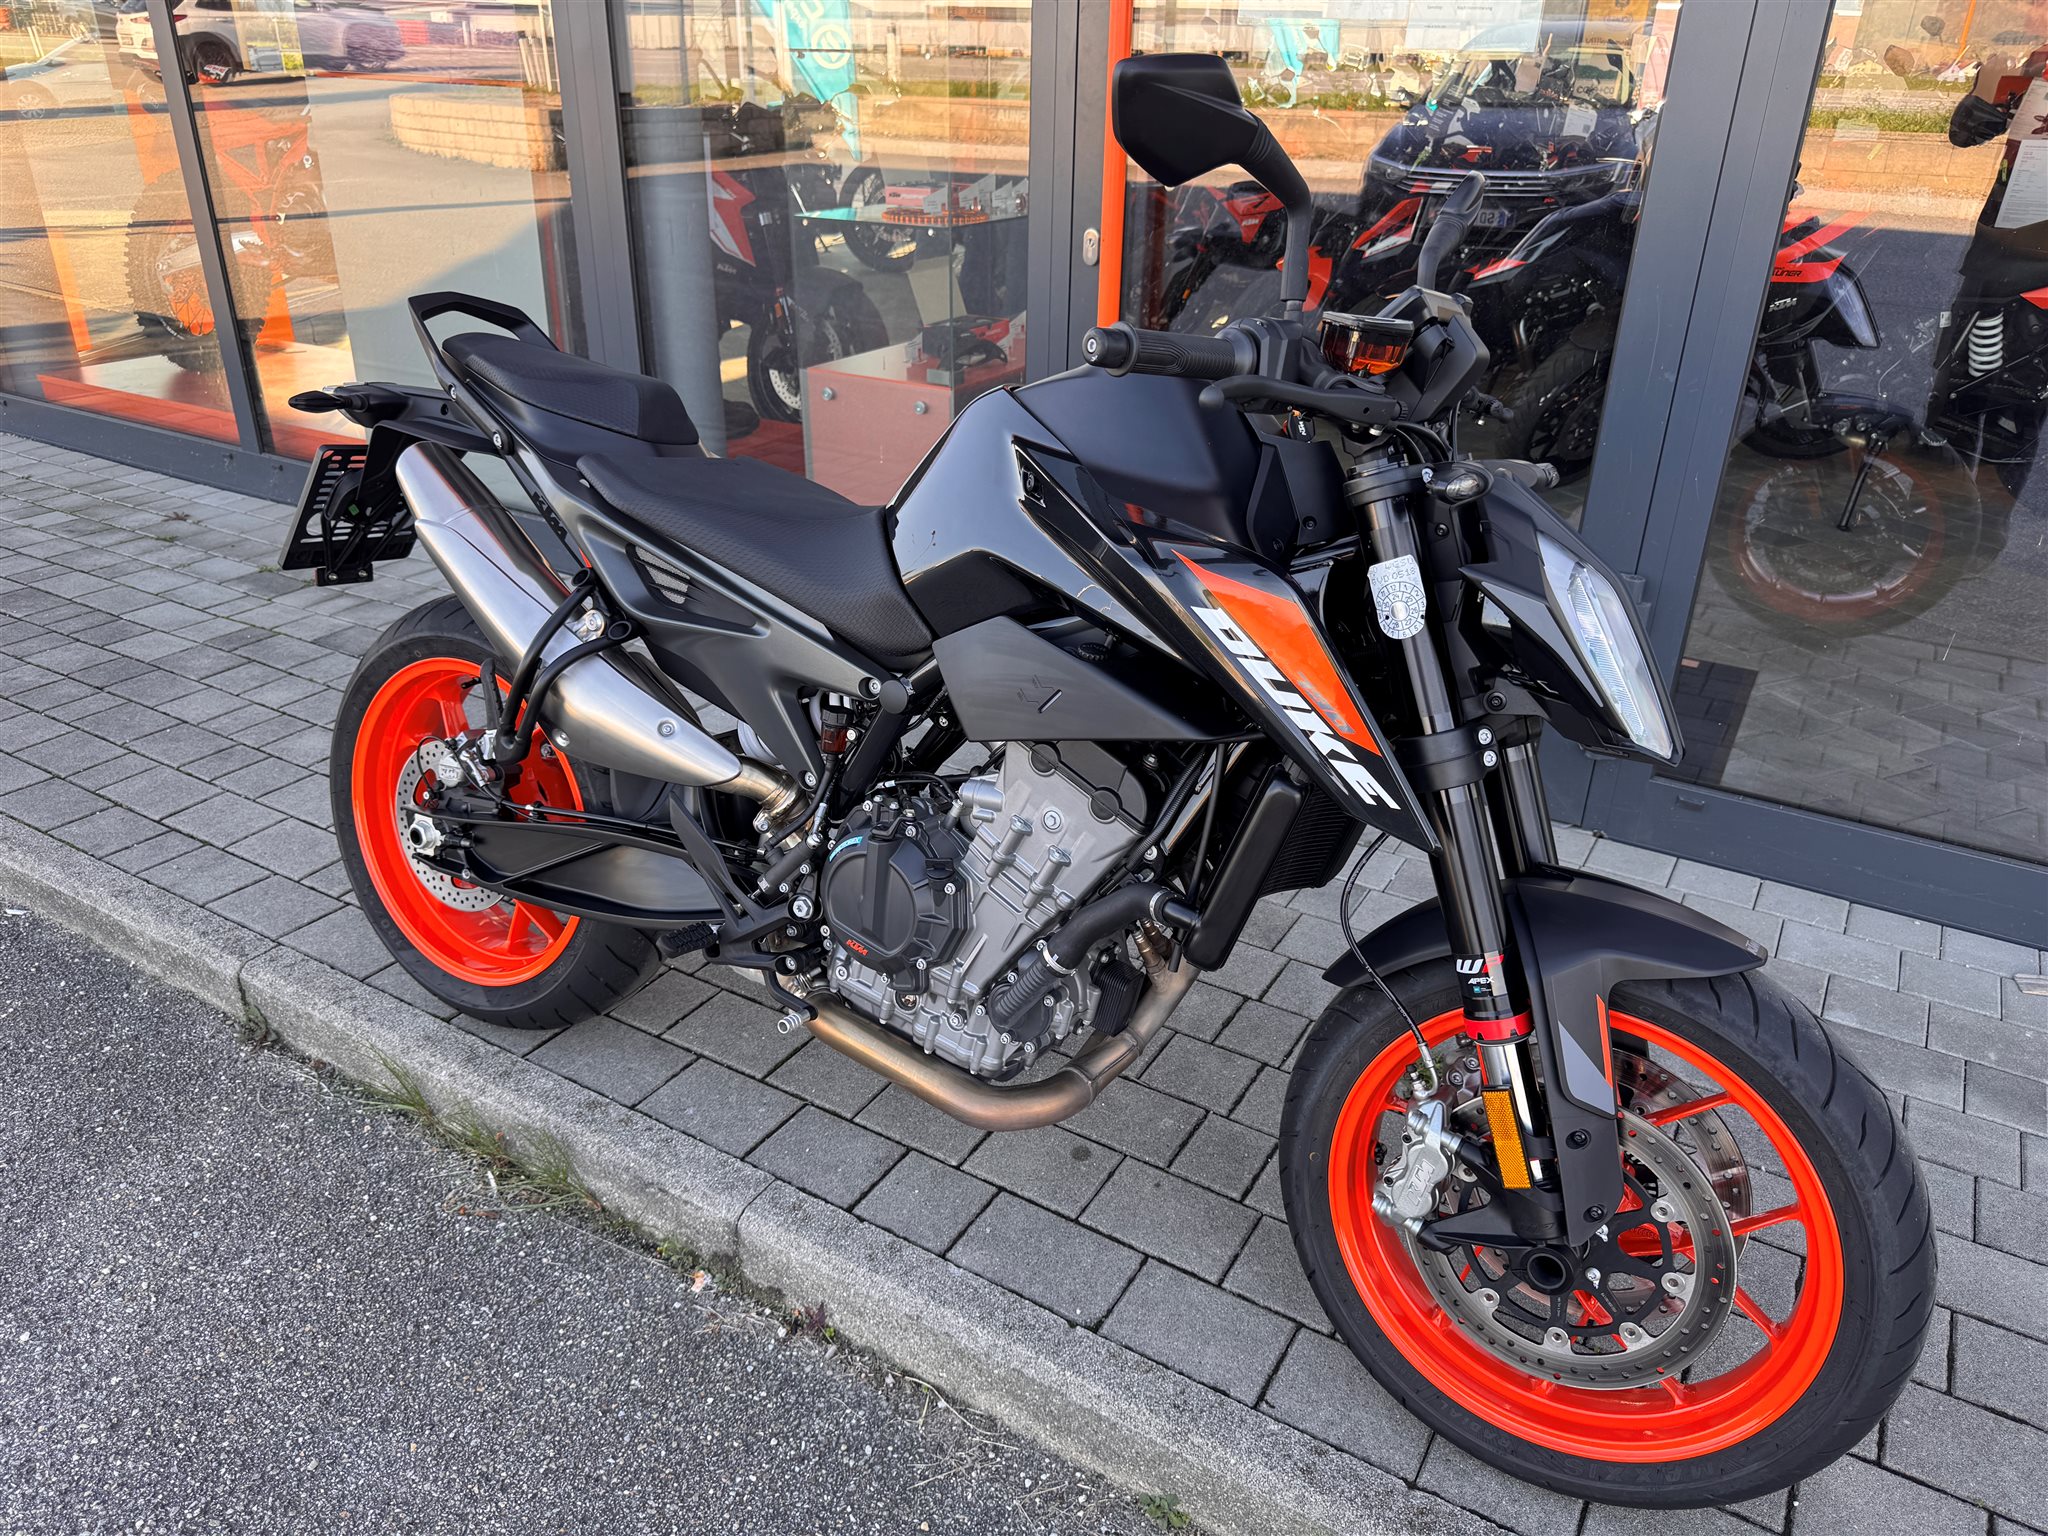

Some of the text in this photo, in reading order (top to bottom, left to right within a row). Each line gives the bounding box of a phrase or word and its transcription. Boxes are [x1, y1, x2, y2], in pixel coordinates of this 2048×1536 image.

[1767, 297, 1798, 313] KTM
[530, 491, 568, 542] KTM
[1190, 606, 1401, 810] DUKE
[845, 938, 869, 956] KTM
[1456, 954, 1505, 975] WP
[1467, 976, 1495, 985] APEX
[1406, 1158, 1436, 1207] KTM
